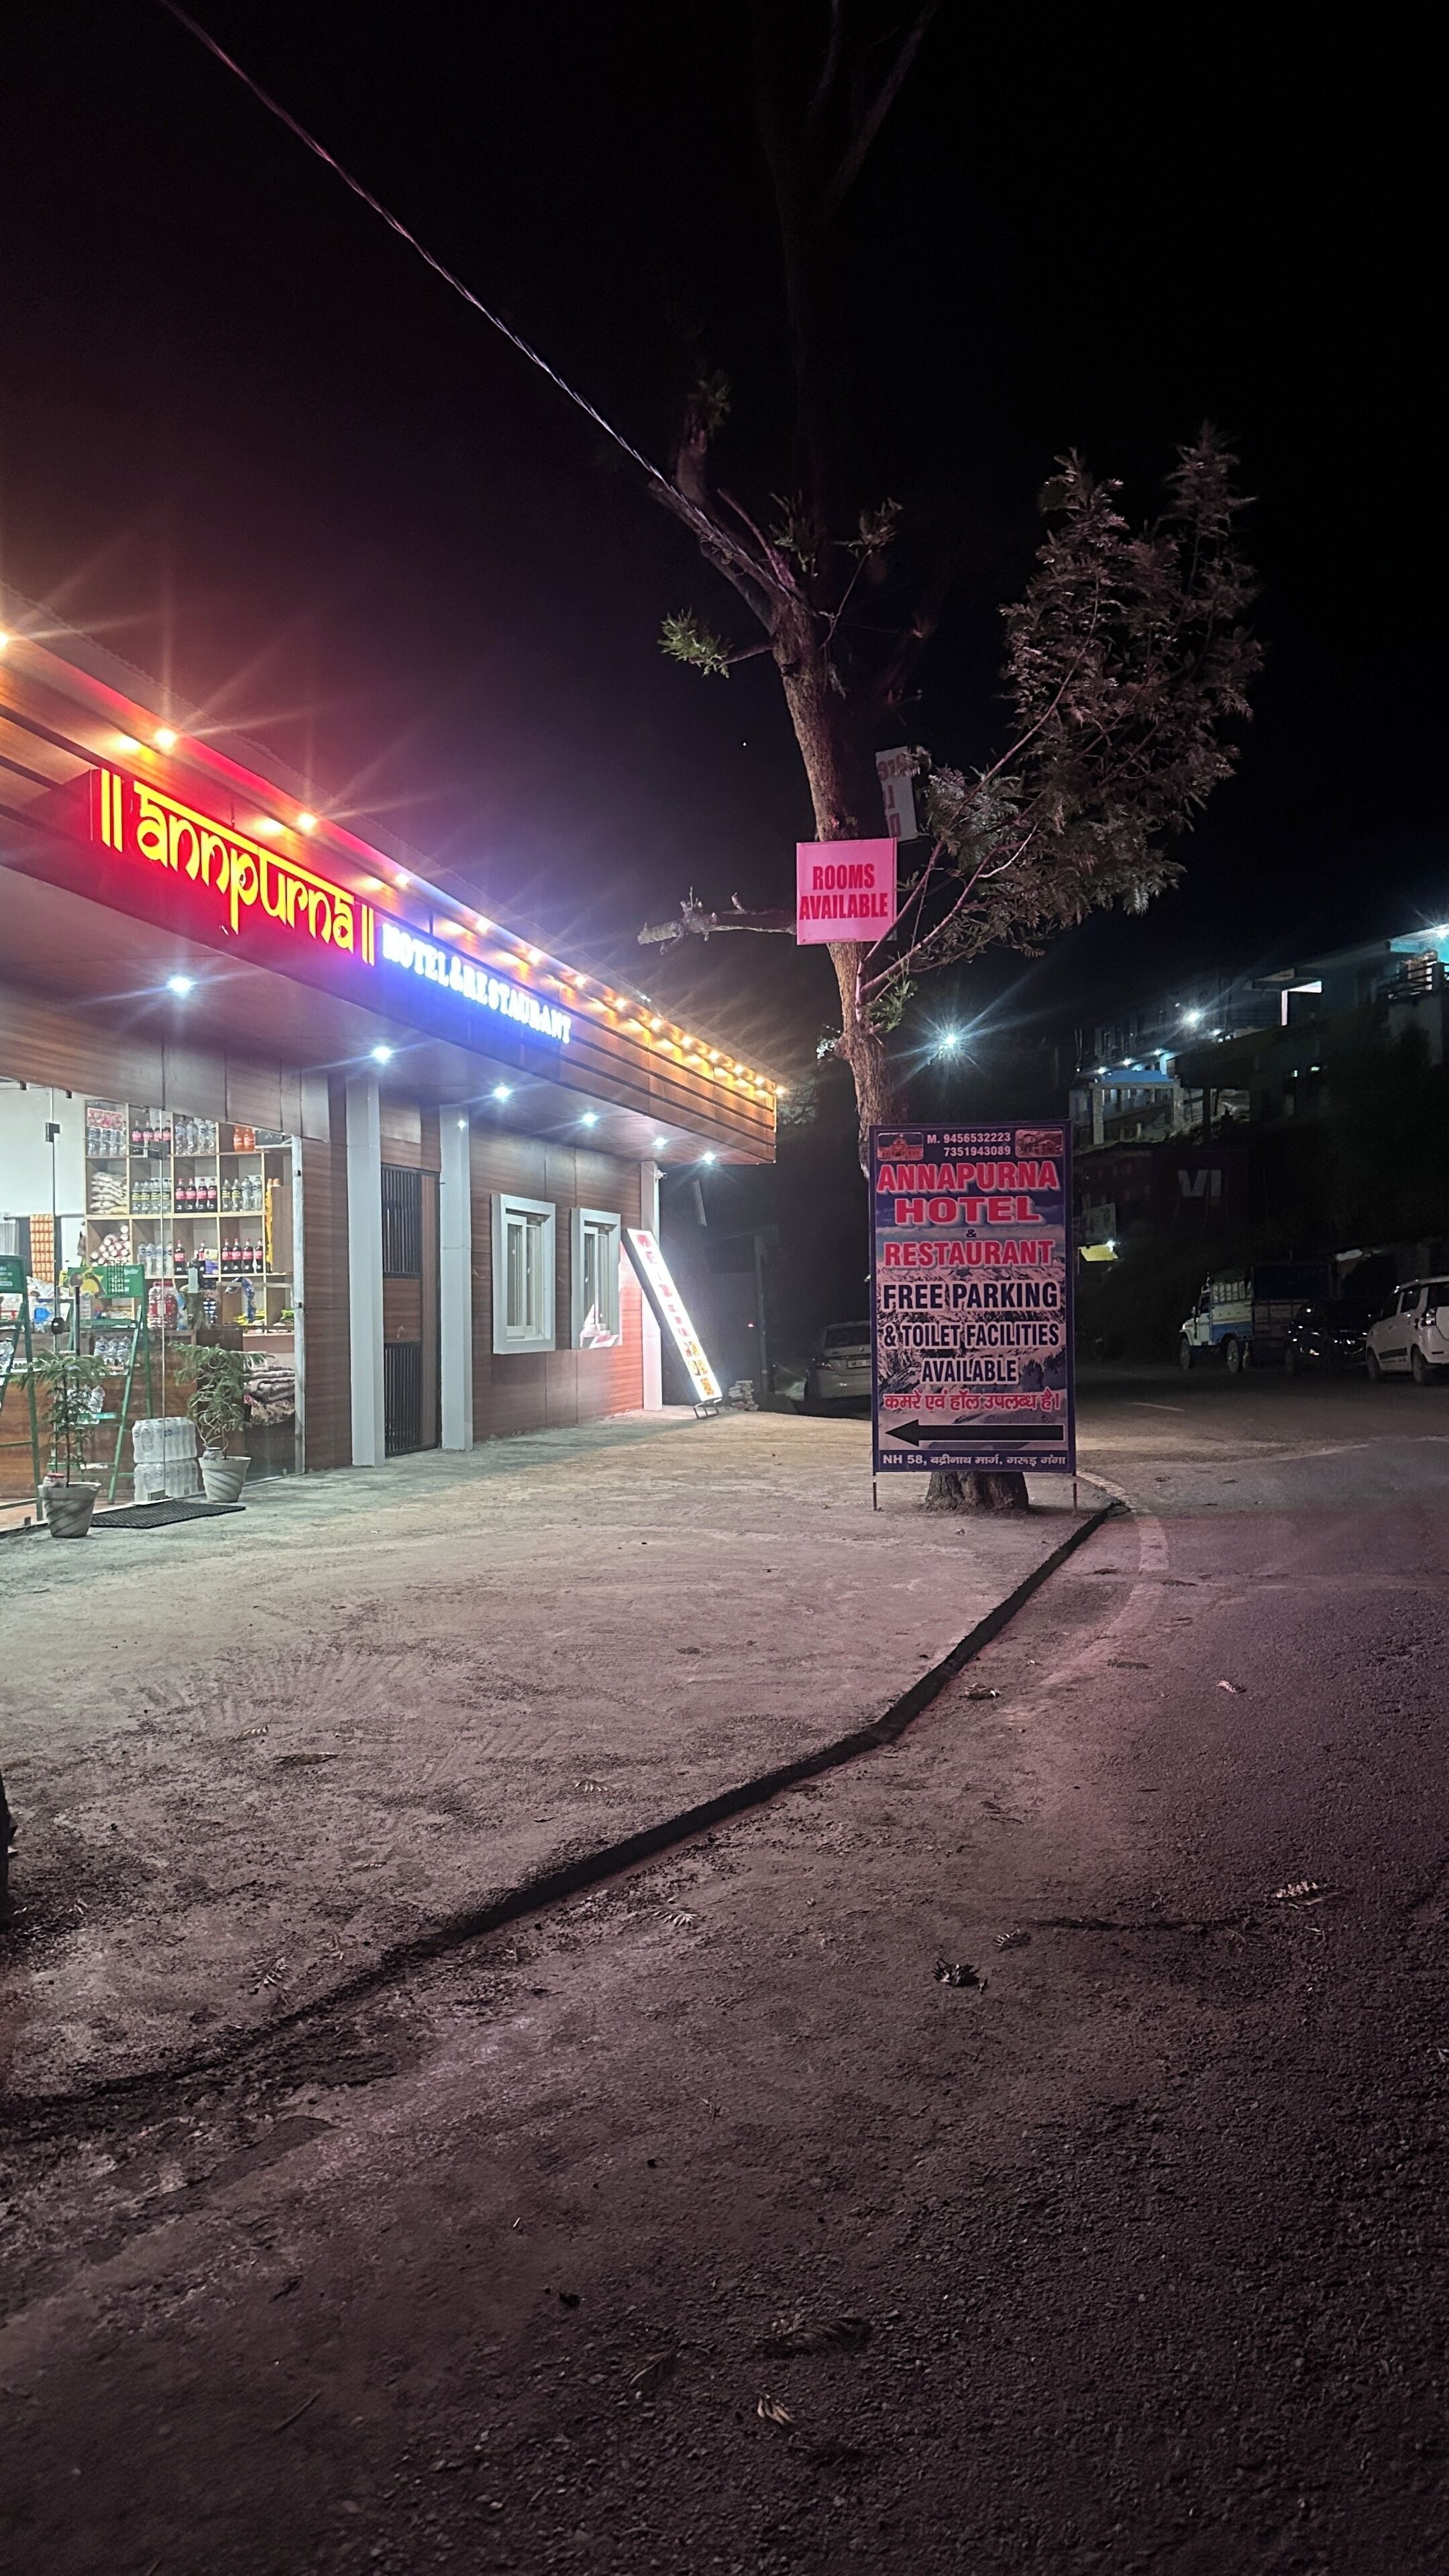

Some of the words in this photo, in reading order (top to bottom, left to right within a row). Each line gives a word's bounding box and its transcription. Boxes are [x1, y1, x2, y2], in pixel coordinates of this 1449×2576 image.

[812, 863, 875, 890] ROOMS
[799, 893, 888, 920] AVAILABLE
[943, 1132, 1011, 1144] 9456532223
[943, 1146, 1011, 1157] 7351943089
[875, 1161, 1061, 1194] ANNAPURNA
[894, 1195, 1044, 1226] HOTEL
[966, 1229, 977, 1238] &
[884, 1240, 1054, 1269] RESTAURANT
[883, 1284, 943, 1309] FREE
[952, 1282, 1057, 1308] PARKING
[884, 1324, 896, 1346] &
[902, 1325, 960, 1346] TOILET
[967, 1323, 1059, 1346] FACILITIES
[922, 1360, 1016, 1382] AVAILABLE
[925, 1391, 947, 1411] एवं
[950, 1390, 979, 1410] हॉल
[984, 1395, 1036, 1409] उपलब्ध
[883, 1454, 902, 1464] NH
[907, 1454, 927, 1465] 58,
[1040, 1454, 1065, 1464] गंगा
